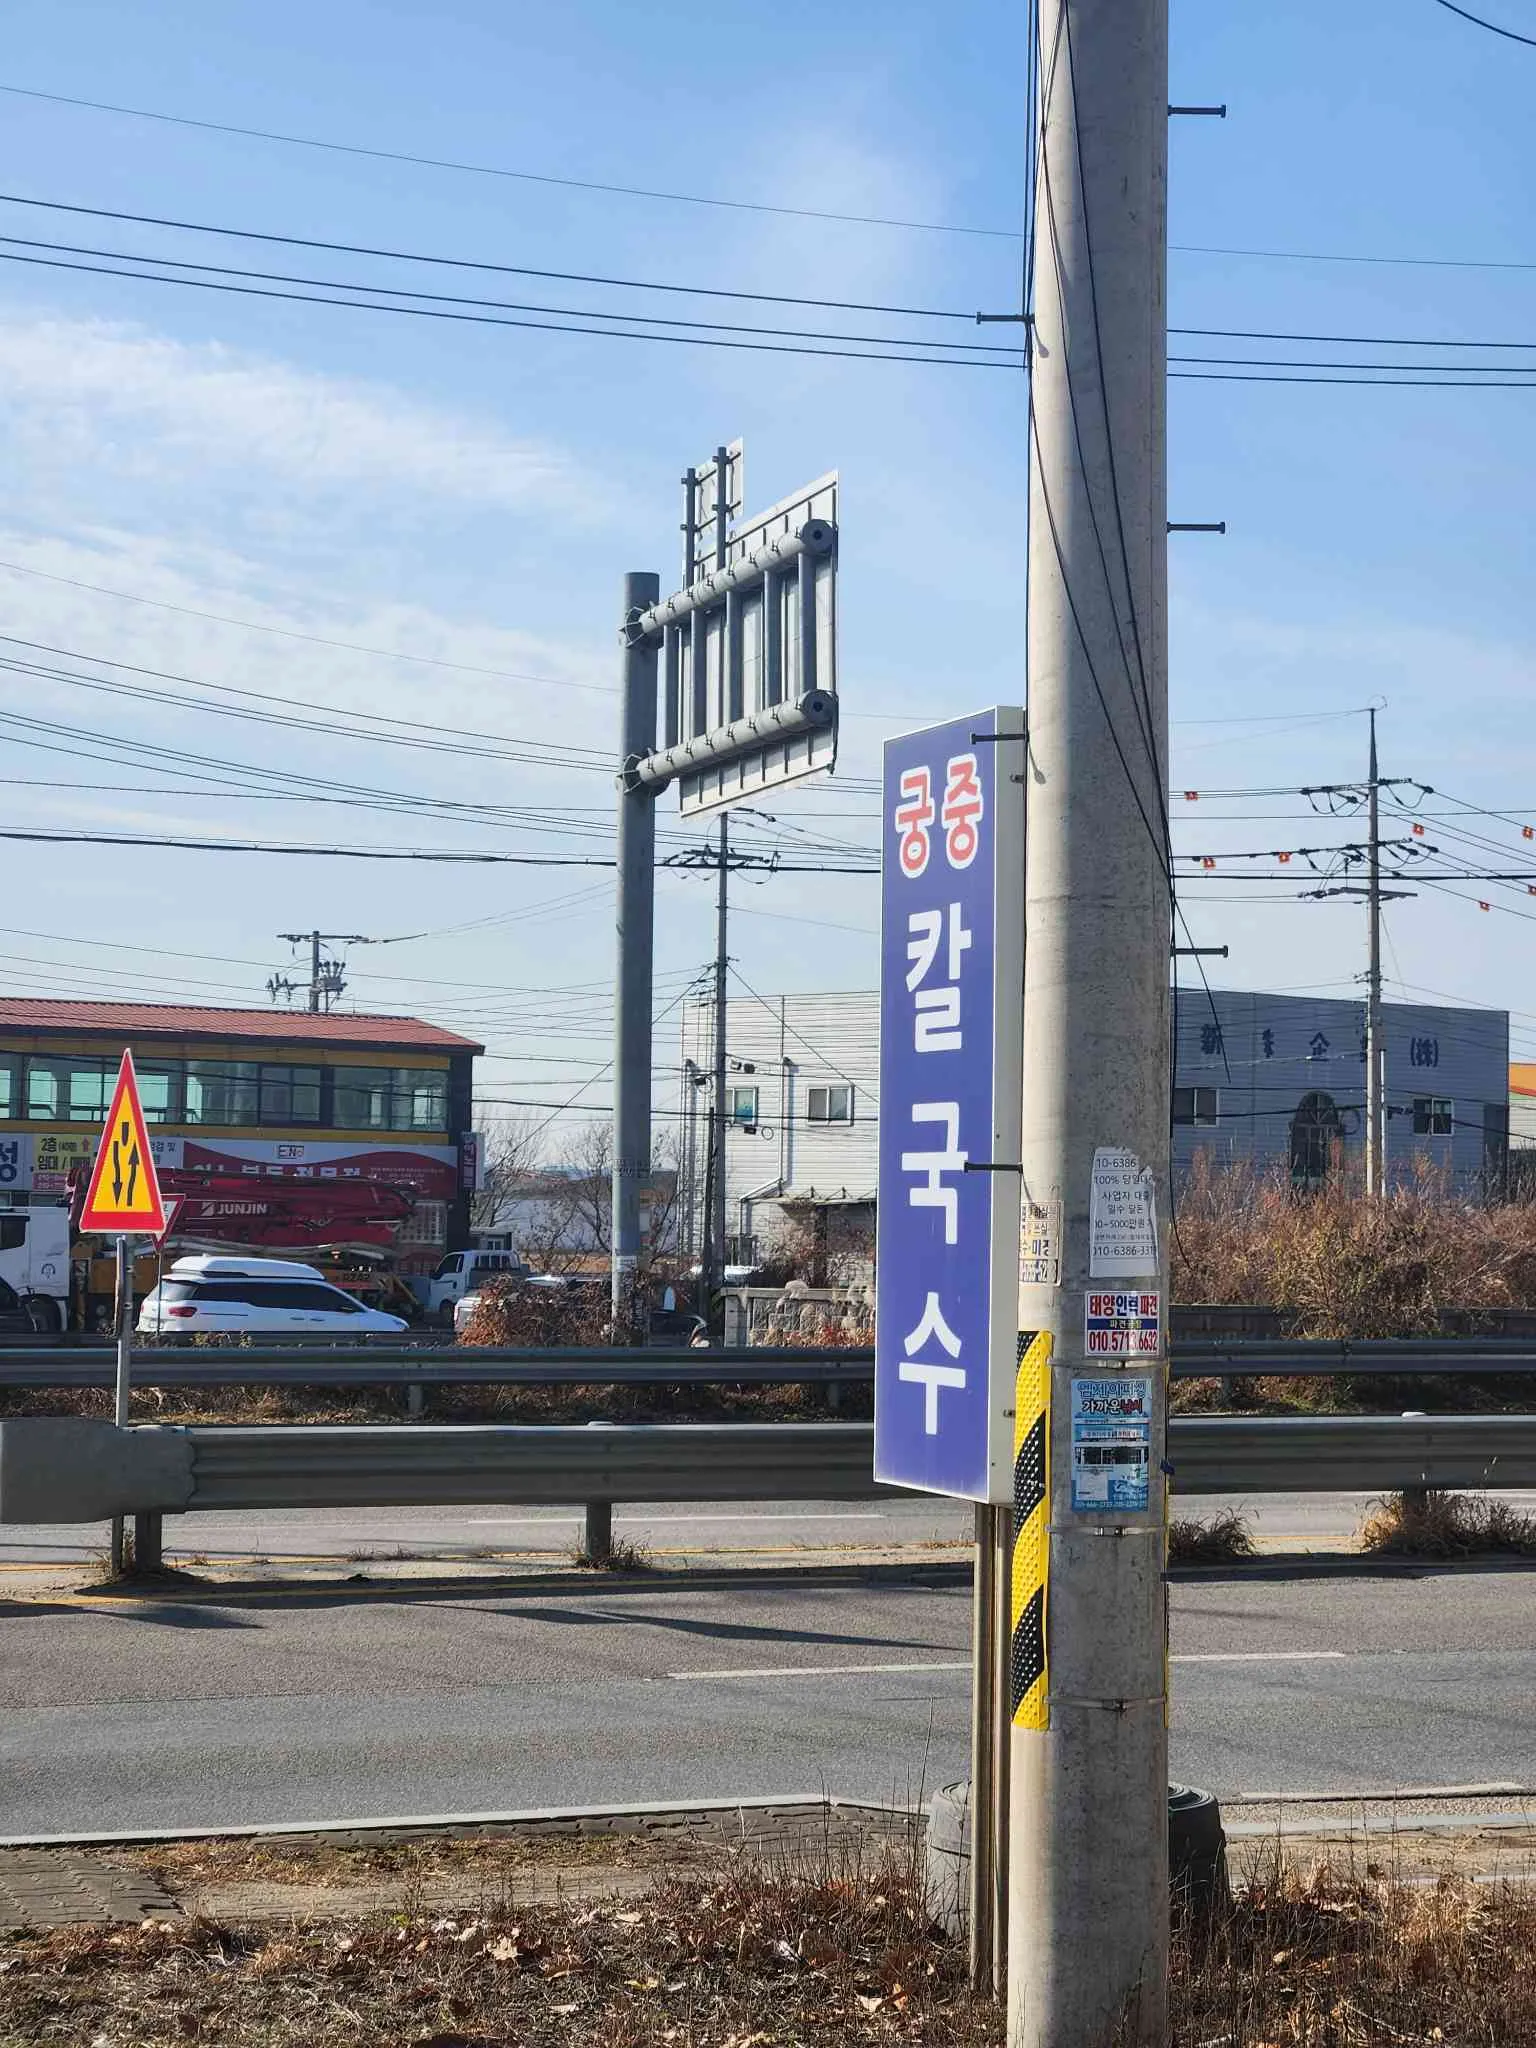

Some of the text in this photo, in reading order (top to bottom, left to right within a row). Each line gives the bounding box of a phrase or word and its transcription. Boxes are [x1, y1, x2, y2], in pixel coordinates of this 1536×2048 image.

[895, 754, 983, 878] 궁중
[216, 1203, 268, 1215] JUNJIN
[899, 902, 971, 1435] 칼국수
